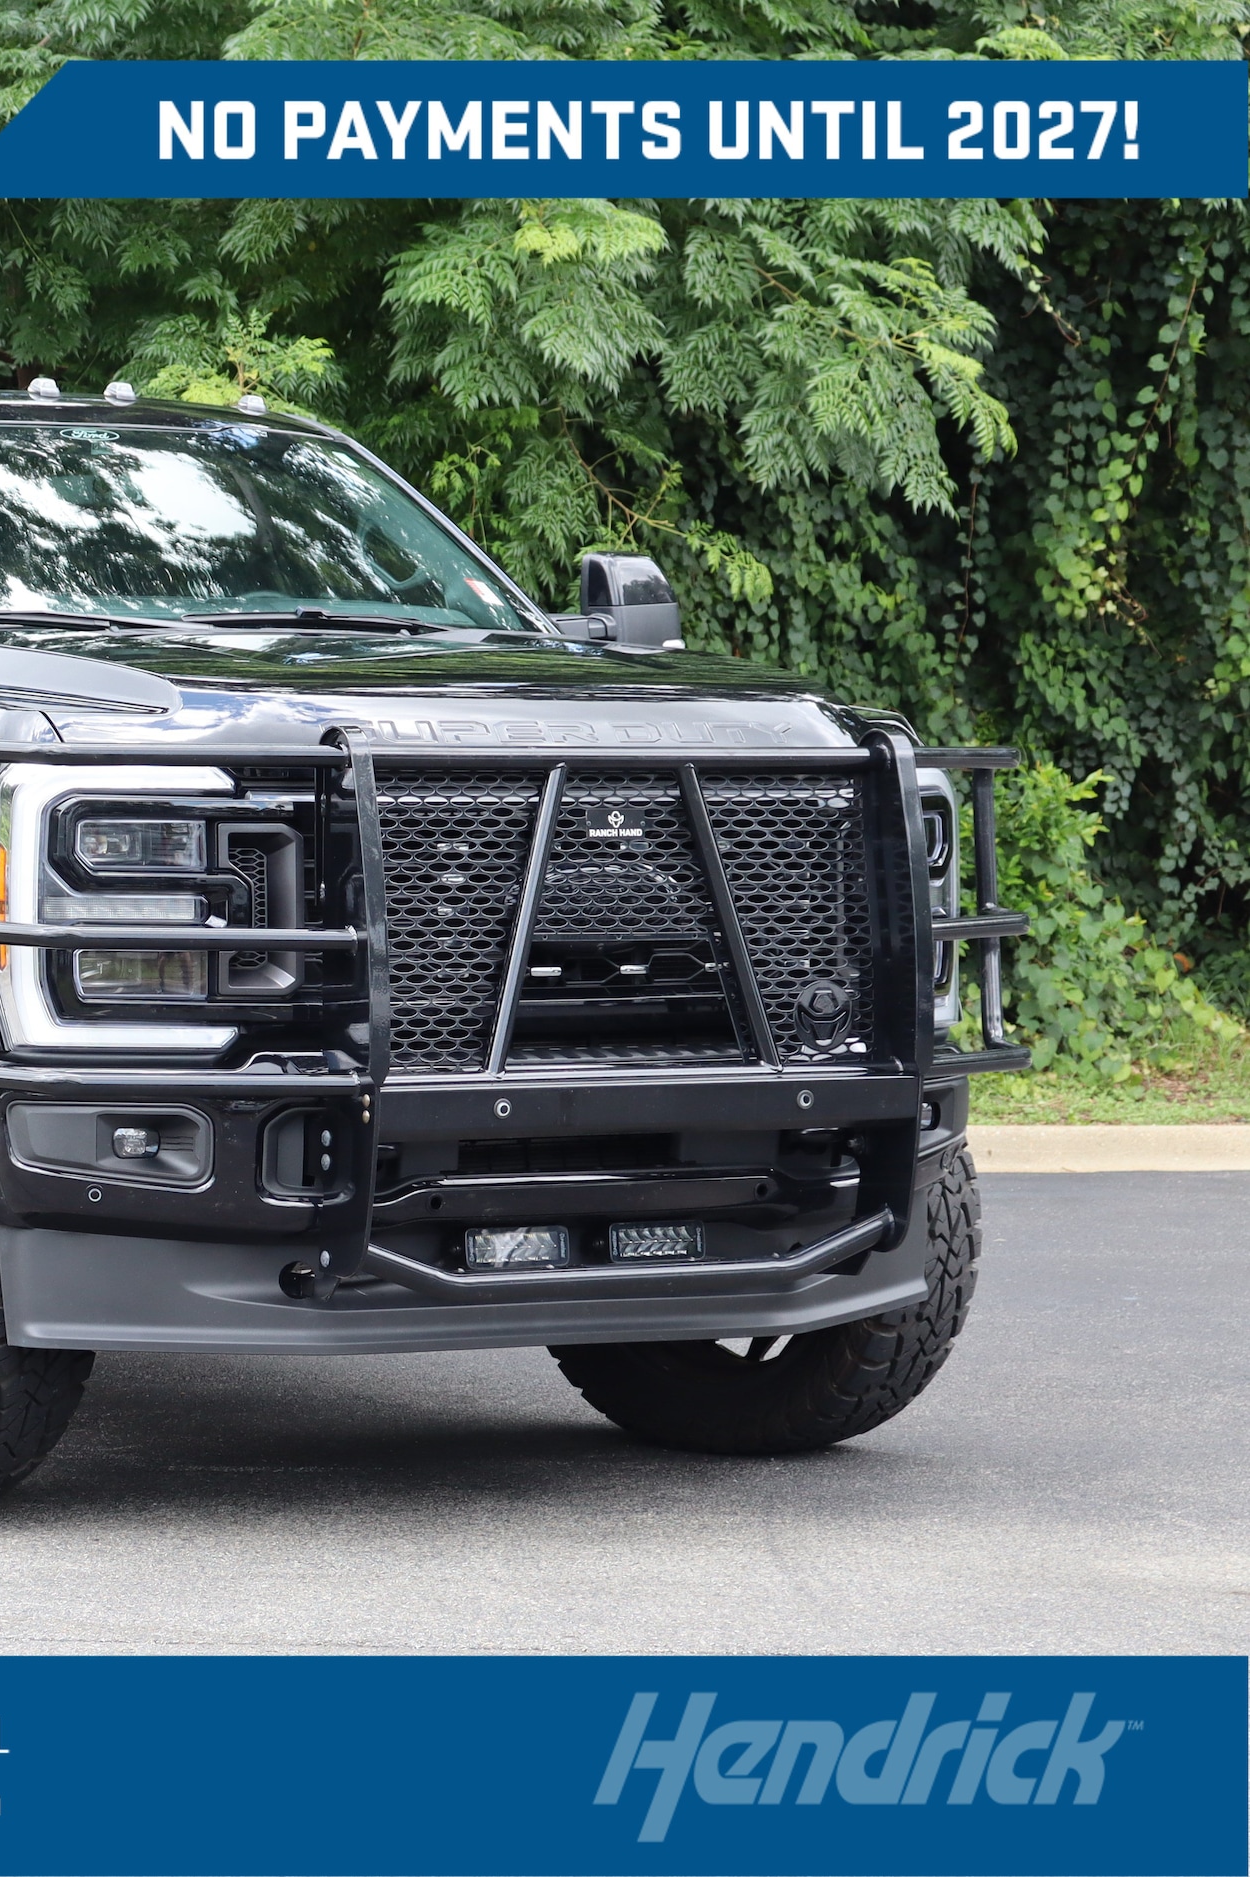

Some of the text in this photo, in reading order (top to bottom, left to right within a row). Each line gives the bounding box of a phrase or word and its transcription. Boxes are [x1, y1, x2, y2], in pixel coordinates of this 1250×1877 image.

[70, 429, 111, 440] Ford
[607, 720, 792, 744] DUTY
[588, 828, 643, 838] RANCH HAND
